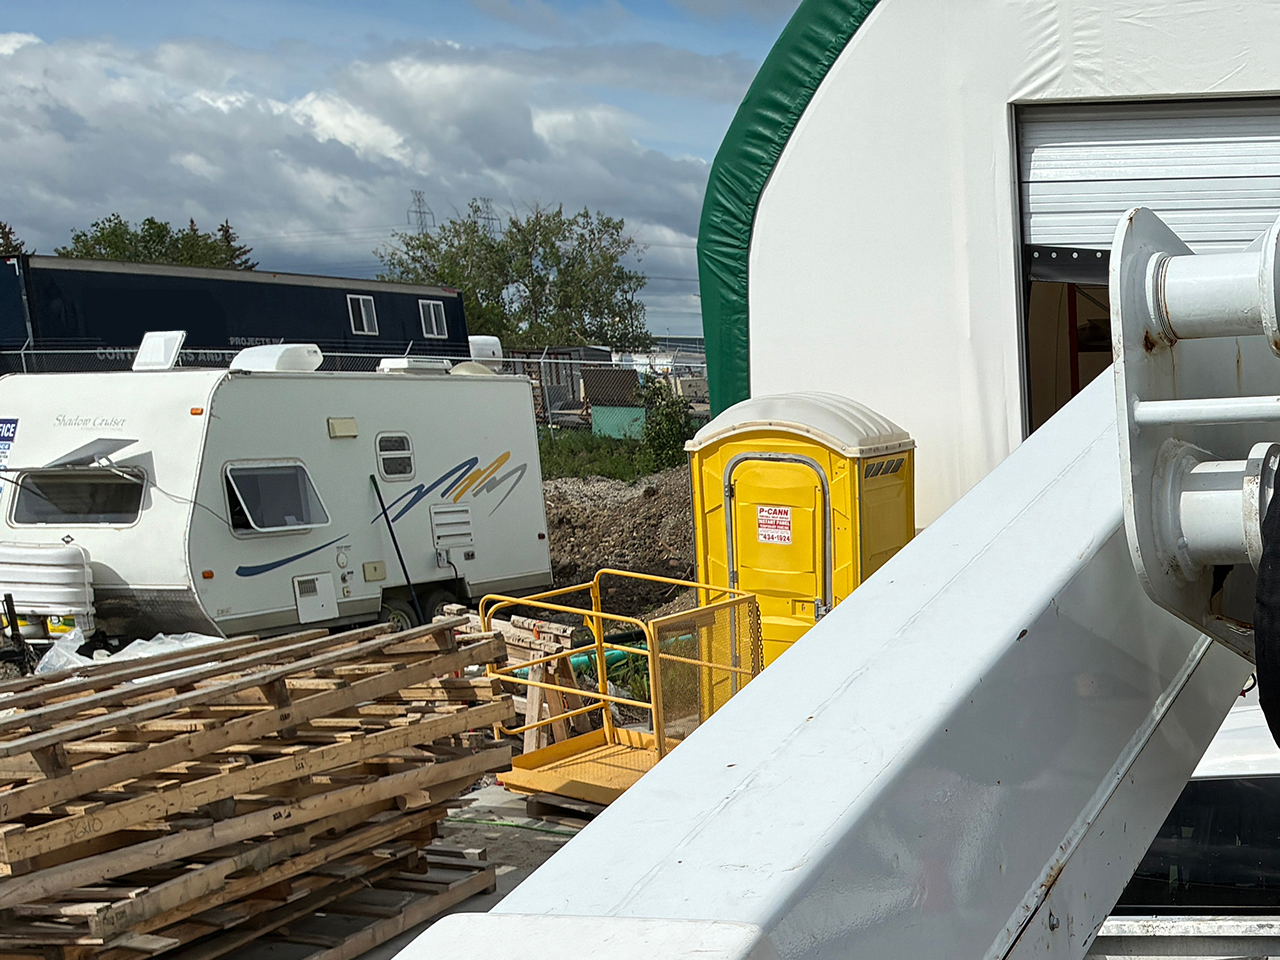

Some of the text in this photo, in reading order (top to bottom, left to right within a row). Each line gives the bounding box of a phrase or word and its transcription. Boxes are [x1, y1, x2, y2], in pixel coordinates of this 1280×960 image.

[53, 414, 127, 428] Shadow Cruiser
[759, 508, 789, 516] P-CANN
